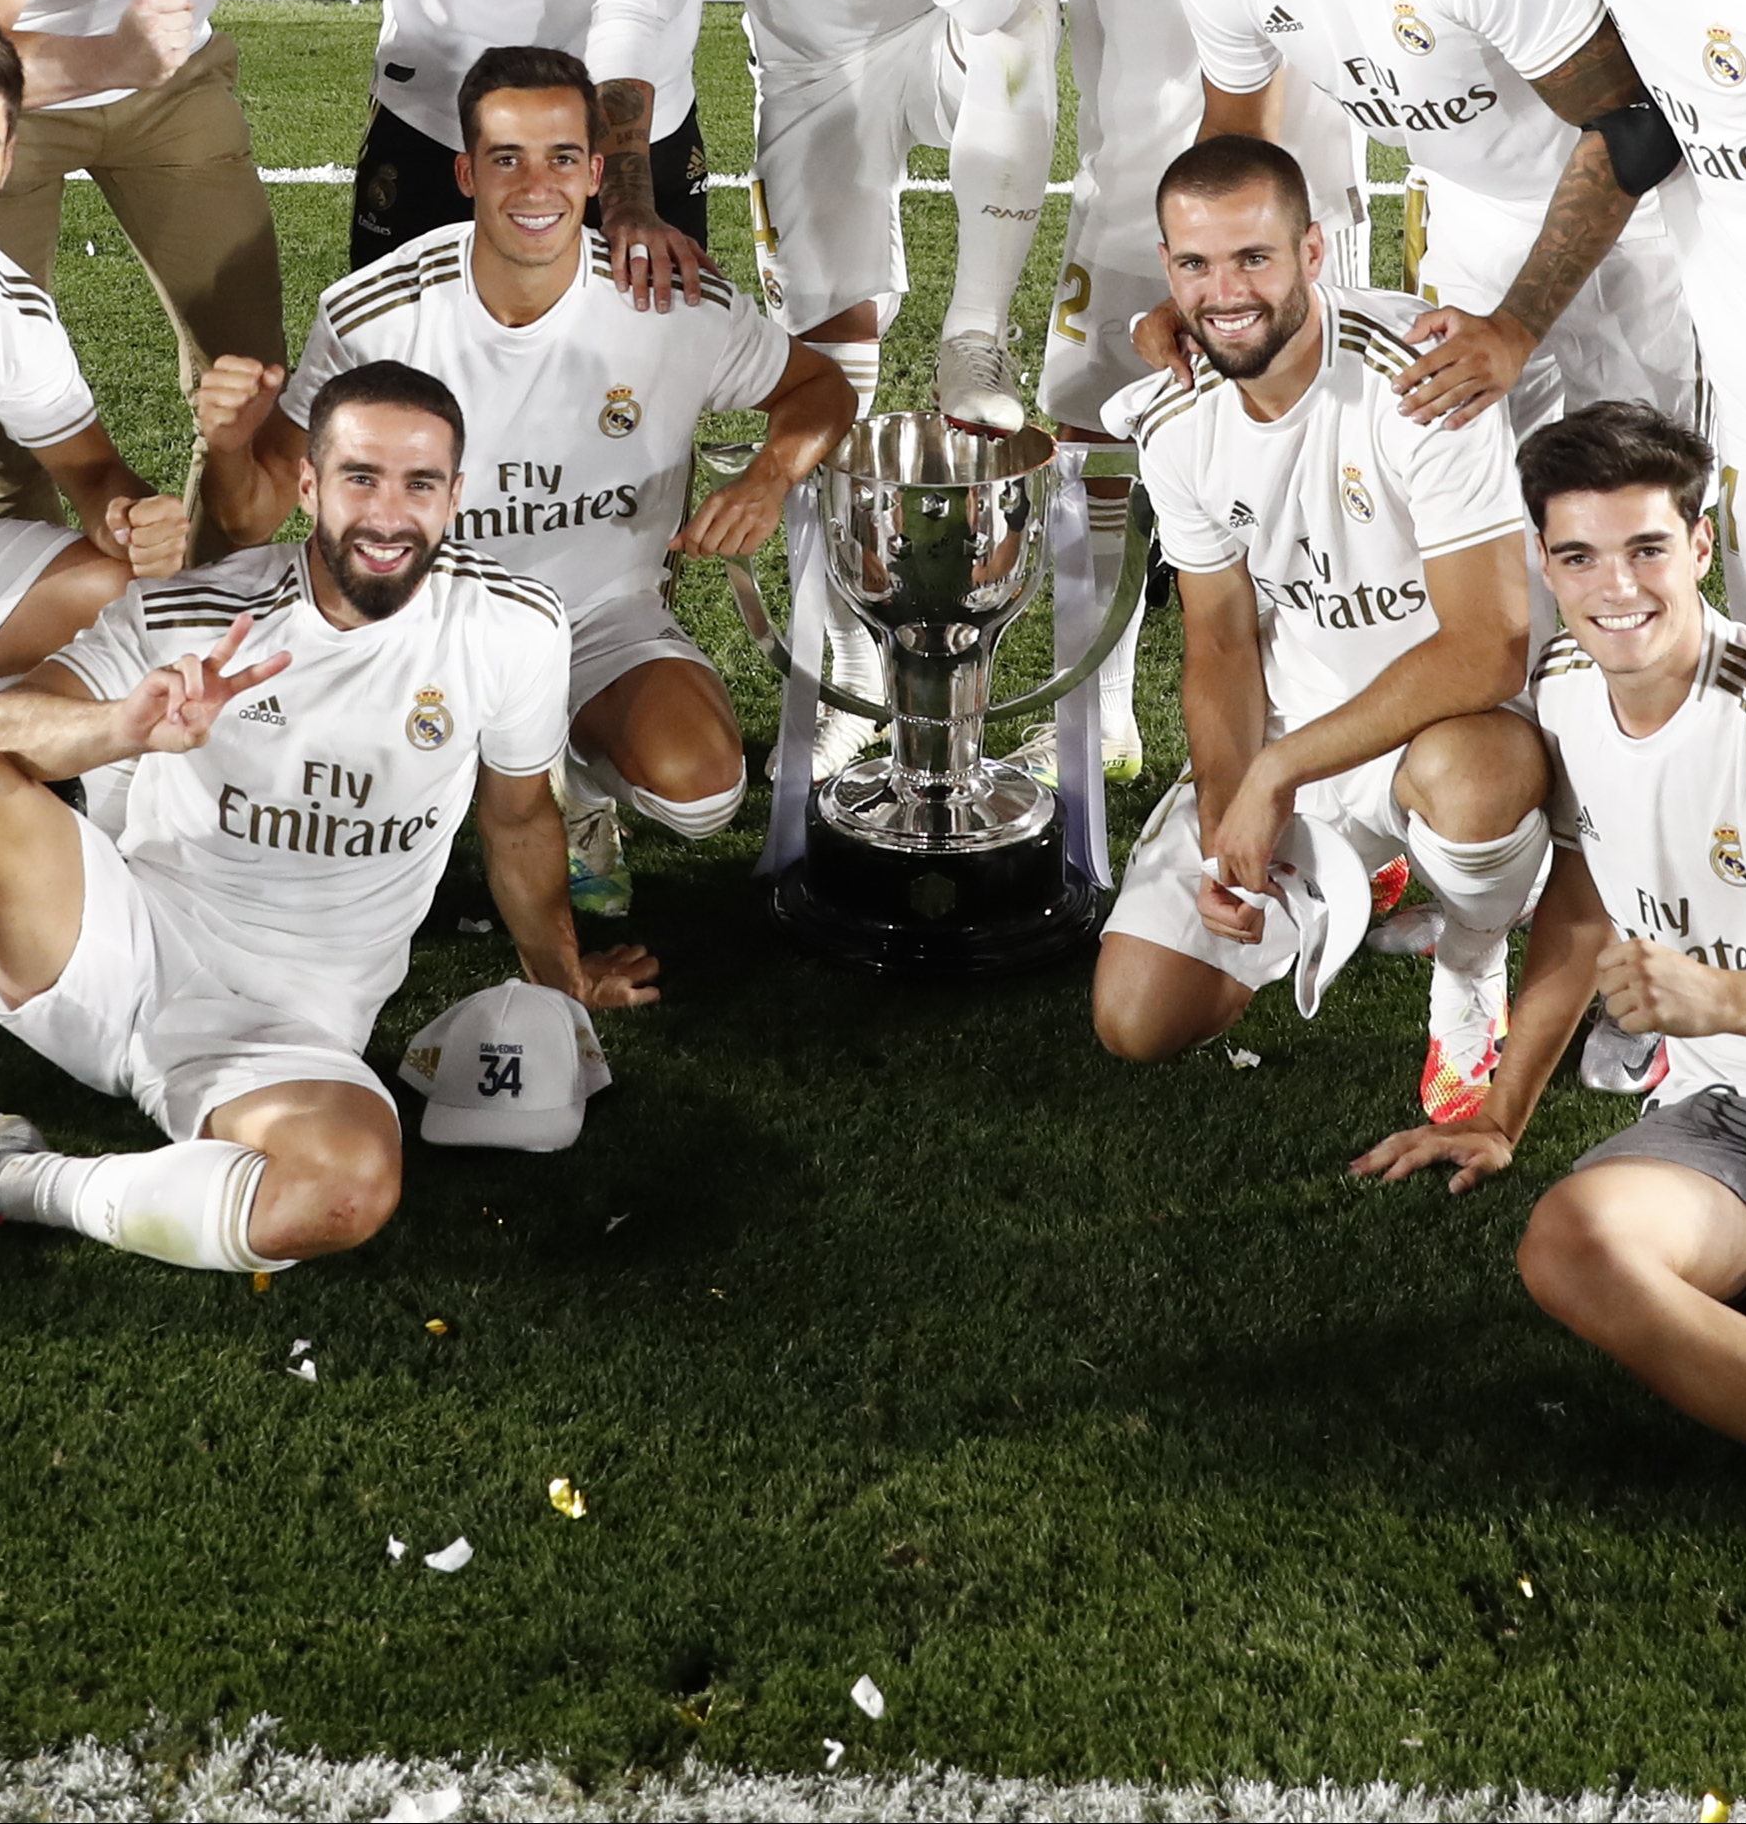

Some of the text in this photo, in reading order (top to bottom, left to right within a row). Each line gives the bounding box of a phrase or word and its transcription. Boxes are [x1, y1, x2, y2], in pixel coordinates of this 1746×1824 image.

[1264, 21, 1305, 34] adidas
[1343, 56, 1401, 96] Fly
[1650, 84, 1700, 135] Fly
[497, 461, 563, 495] Fly
[444, 484, 639, 541] mirates
[239, 707, 287, 726] adidas
[303, 760, 373, 809] Fly
[1636, 887, 1689, 938] Fly
[478, 1055, 522, 1098] 34
